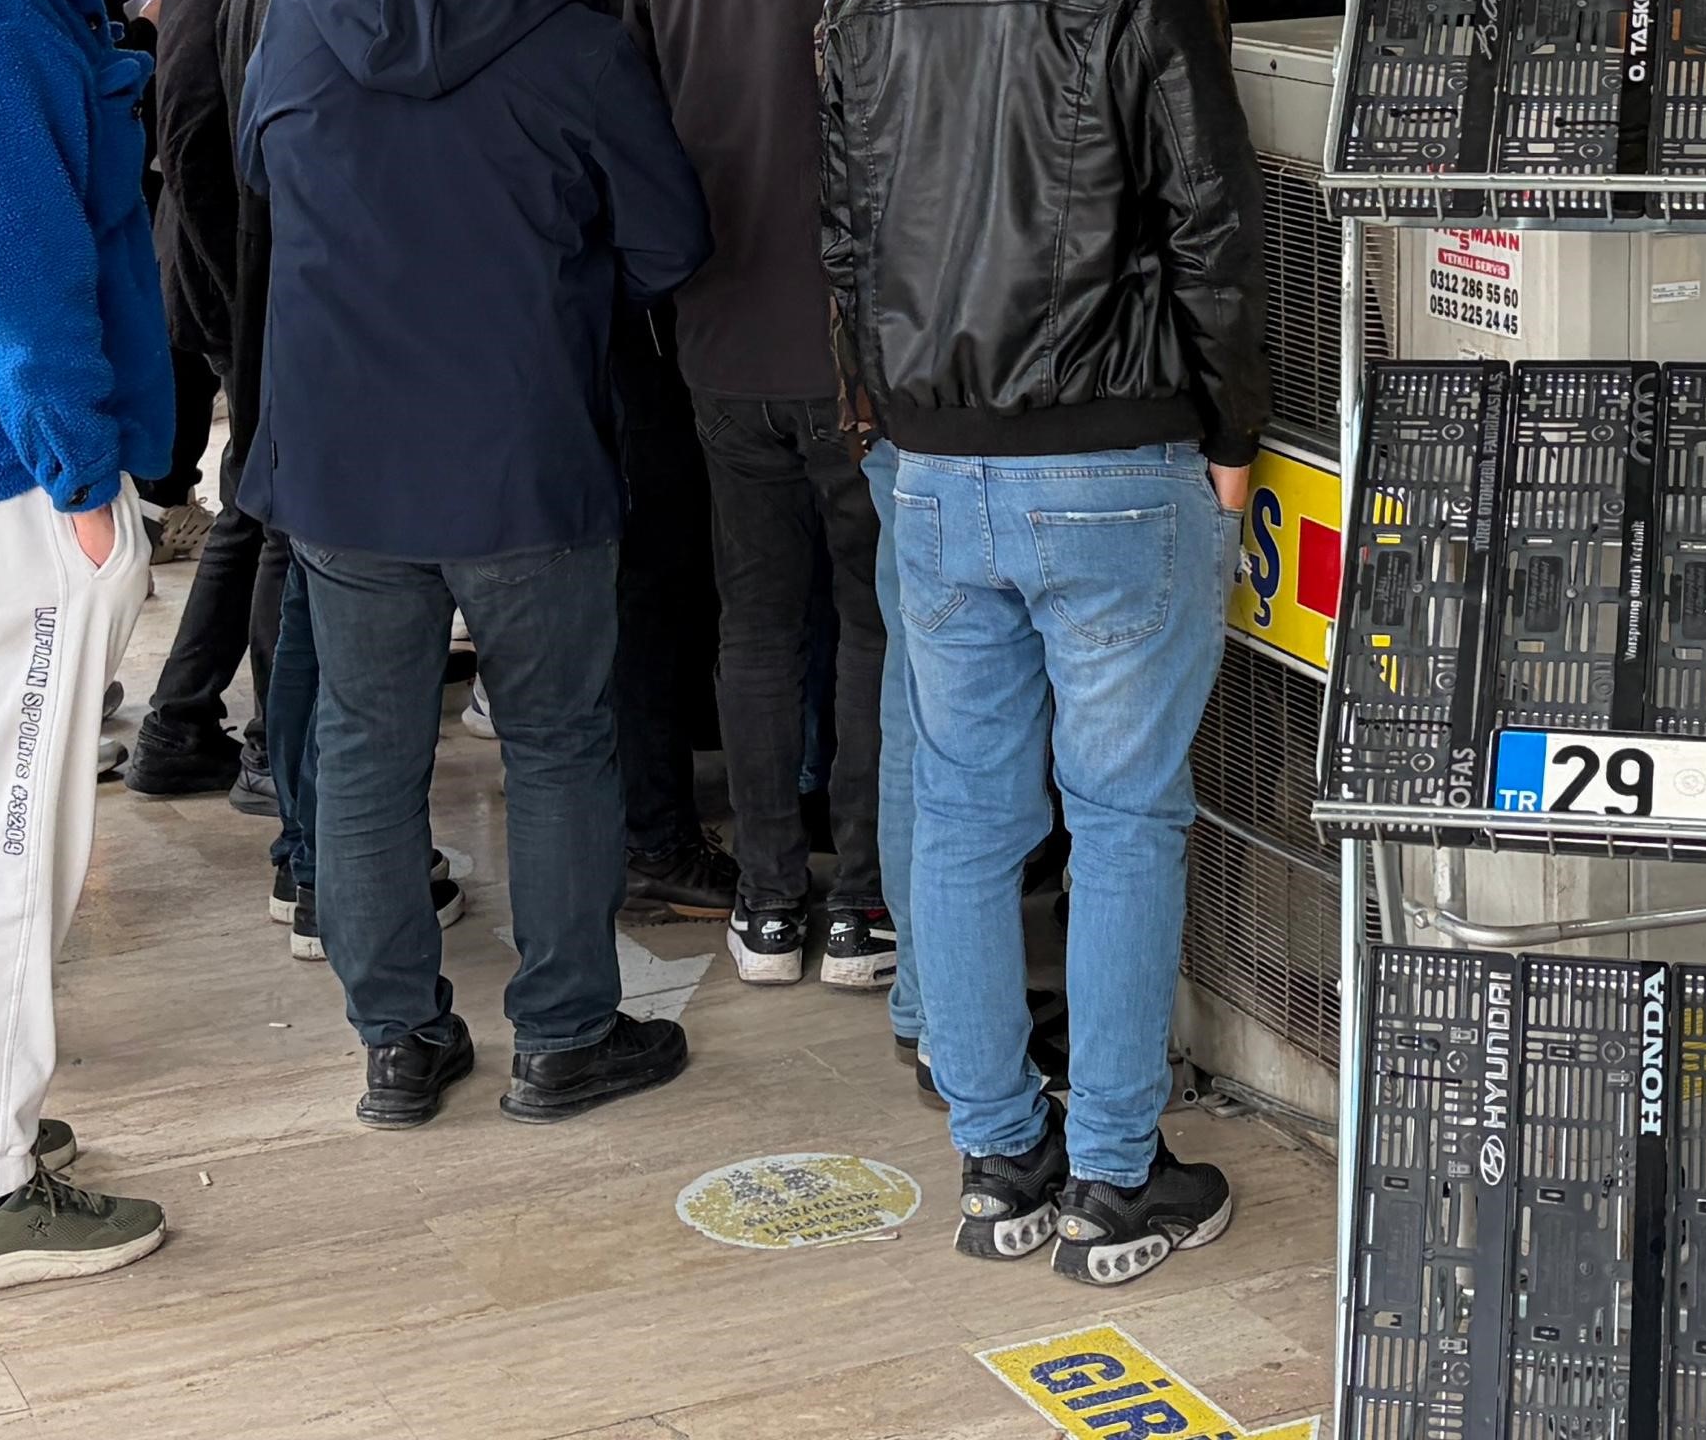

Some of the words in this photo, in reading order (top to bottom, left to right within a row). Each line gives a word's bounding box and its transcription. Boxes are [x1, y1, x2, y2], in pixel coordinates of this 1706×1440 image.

[1430, 268, 1458, 294] 0312
[1461, 276, 1483, 301] 286
[1486, 281, 1501, 304] 55
[1503, 286, 1519, 310] 60
[1430, 296, 1458, 321] 0533
[1461, 303, 1483, 327] 225
[1486, 308, 1501, 332] 24
[1503, 313, 1519, 336] 45
[1631, 519, 1646, 563] Technik
[1628, 563, 1642, 599] durch
[26, 606, 58, 688] LUFIAN
[1625, 599, 1642, 661] Vorsprung
[16, 692, 44, 780] SPORTS
[1449, 746, 1475, 809] OFAŞ
[1499, 789, 1537, 813] TR
[1549, 745, 1655, 817] 29
[3, 784, 30, 857] #3209
[1483, 971, 1512, 1129] HYUNDAI
[1640, 966, 1665, 1137] HONDA
